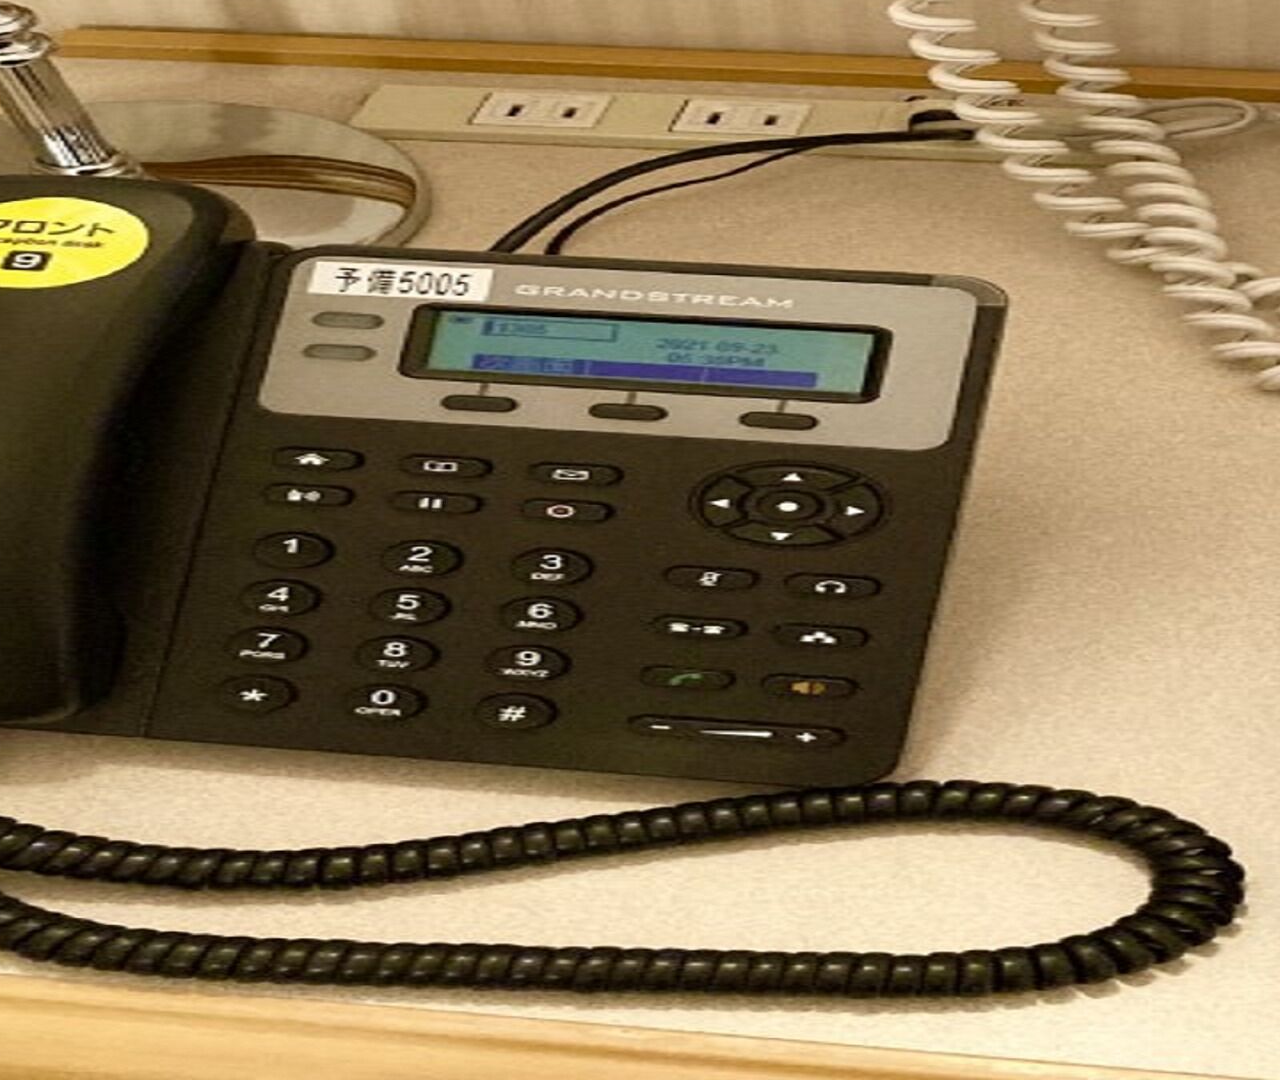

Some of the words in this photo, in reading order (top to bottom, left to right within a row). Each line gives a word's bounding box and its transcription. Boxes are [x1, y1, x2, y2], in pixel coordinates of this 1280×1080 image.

[11, 252, 42, 269] 9
[334, 267, 474, 297] 予備5005
[514, 284, 795, 310] GRANDSTREAM
[283, 538, 299, 554] 1
[407, 546, 433, 562] 2
[539, 554, 563, 570] 3
[267, 587, 289, 602] 4
[395, 594, 421, 611] 5
[527, 603, 554, 619] 6
[257, 633, 280, 648] 7
[383, 641, 408, 658] 8
[515, 651, 542, 667] 9
[370, 689, 396, 705] 0
[354, 707, 402, 717] OPER
